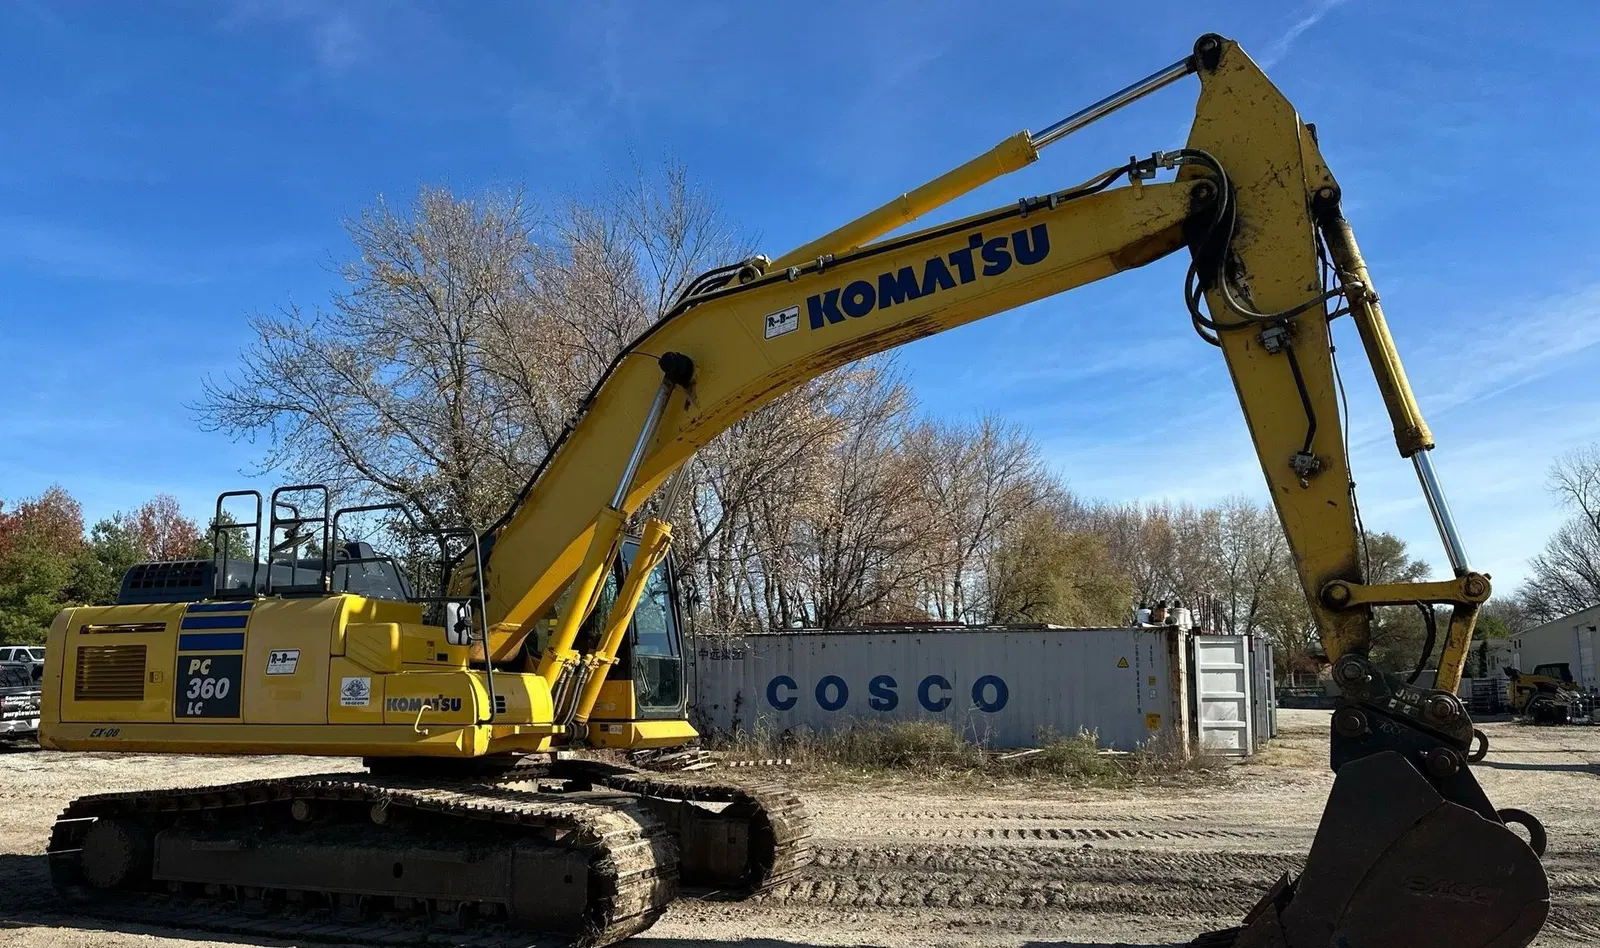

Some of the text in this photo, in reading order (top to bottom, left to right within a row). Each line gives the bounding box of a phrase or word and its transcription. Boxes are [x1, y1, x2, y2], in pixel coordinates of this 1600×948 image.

[807, 223, 1051, 330] KOMATSU
[188, 658, 212, 675] PC
[186, 677, 231, 699] 360
[766, 674, 1010, 713] COSCO
[186, 702, 203, 715] LC
[386, 694, 462, 712] KOMATSU
[90, 728, 120, 738] EX-08
